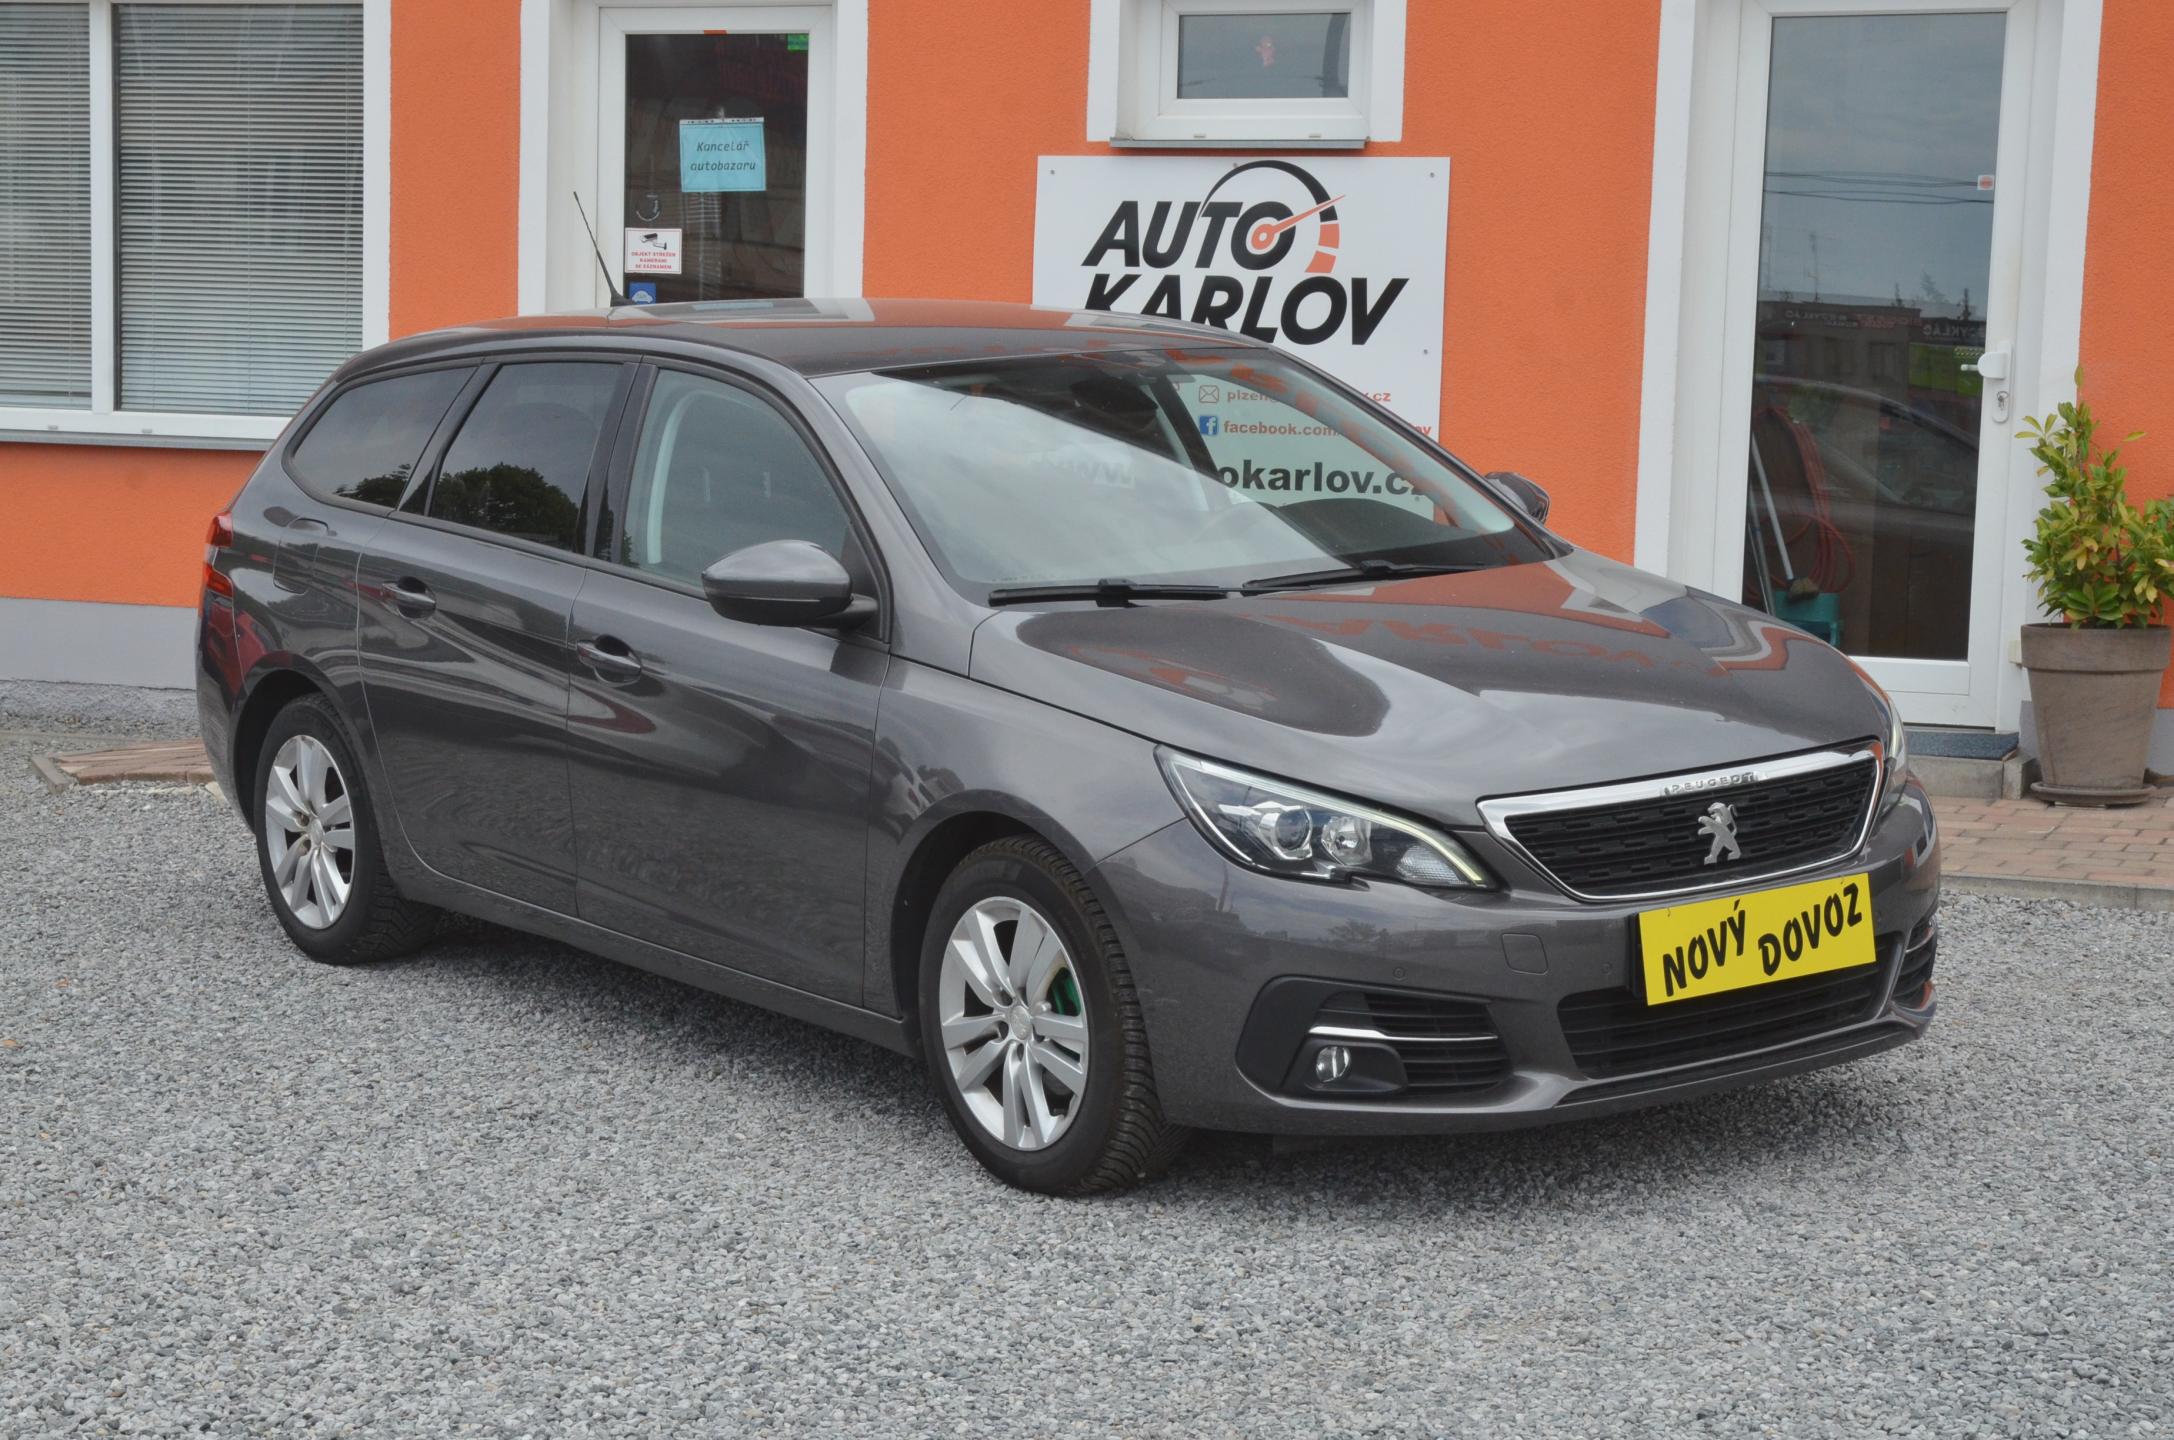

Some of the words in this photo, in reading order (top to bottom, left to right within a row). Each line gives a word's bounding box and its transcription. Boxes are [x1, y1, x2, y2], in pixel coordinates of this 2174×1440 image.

[690, 159, 757, 171] autobazaru
[696, 141, 750, 152] Kancelář
[1081, 200, 1297, 271] AUTO
[1085, 273, 1410, 345] KARLOV
[1671, 771, 1754, 793] PEUGEOT
[1662, 898, 1746, 997] NOVÝ
[1757, 882, 1863, 977] DOVOZ
